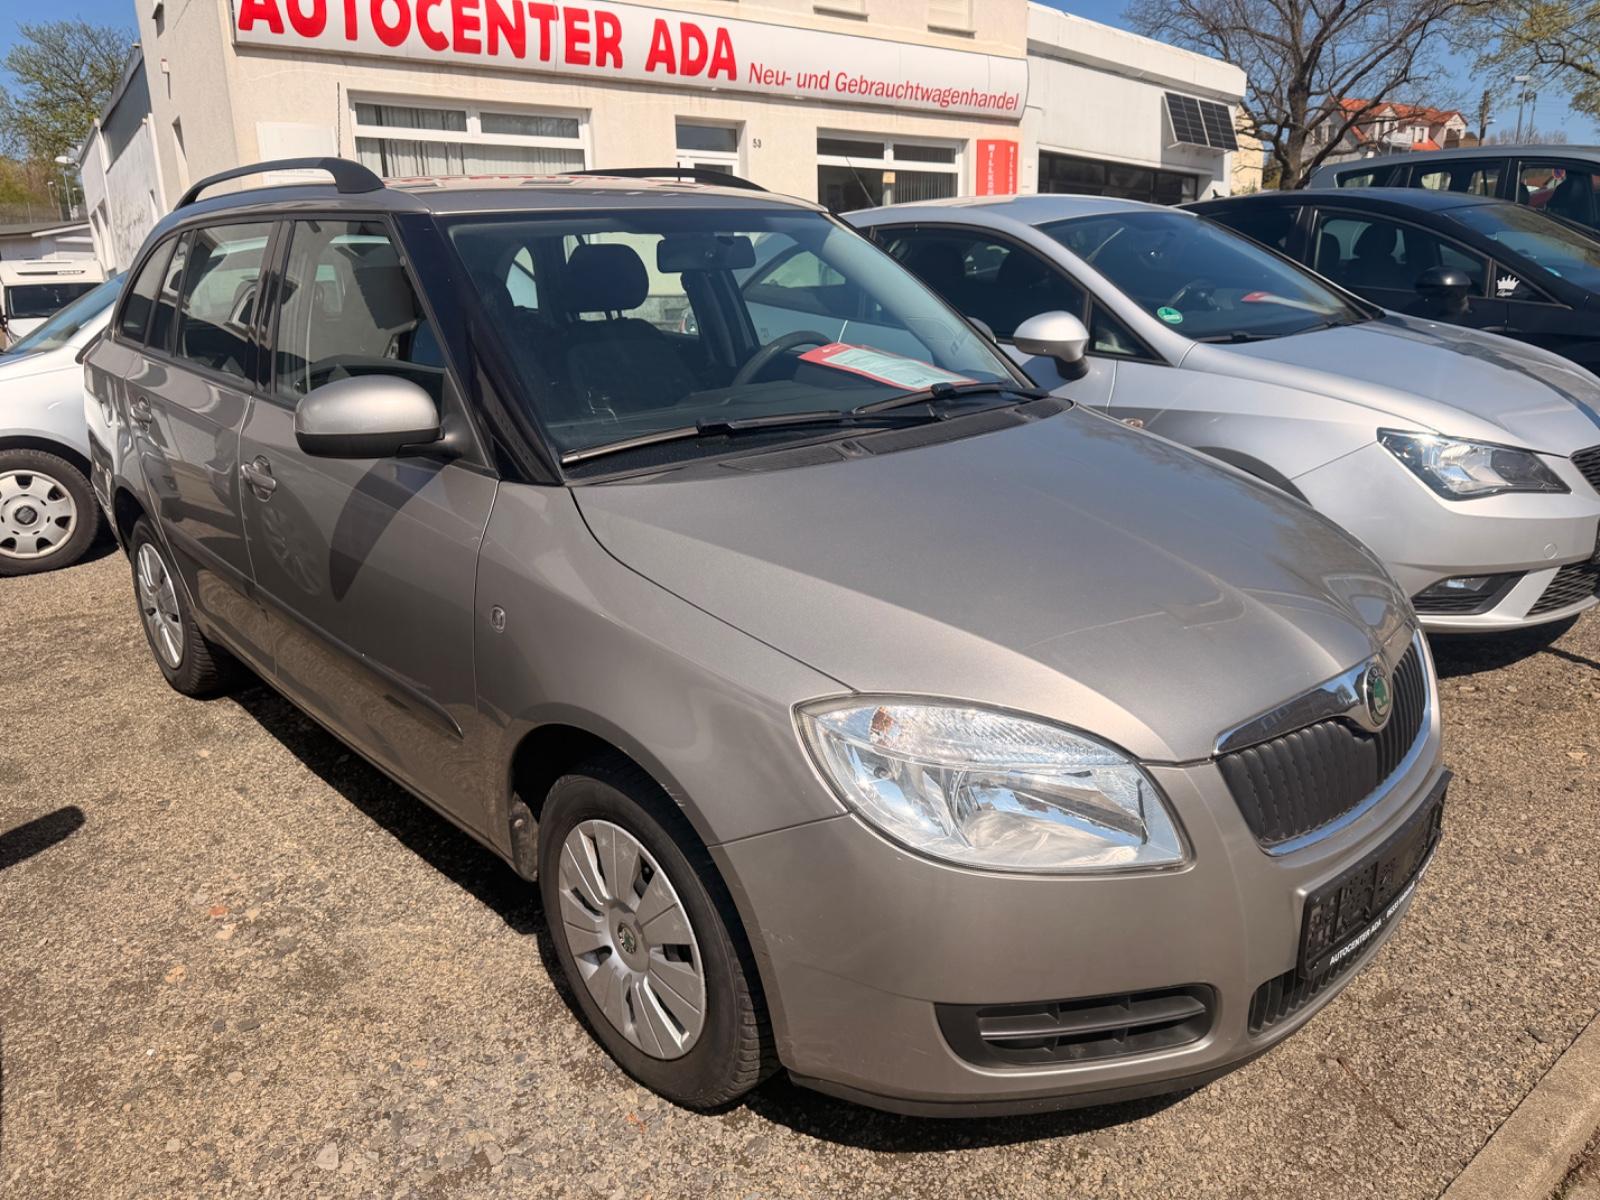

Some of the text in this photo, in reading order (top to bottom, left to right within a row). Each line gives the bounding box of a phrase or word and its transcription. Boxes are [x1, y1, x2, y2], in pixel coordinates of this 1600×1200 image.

[645, 18, 737, 81] ADA
[748, 62, 1019, 111] Neu- und Gebrauchtwagenhandel
